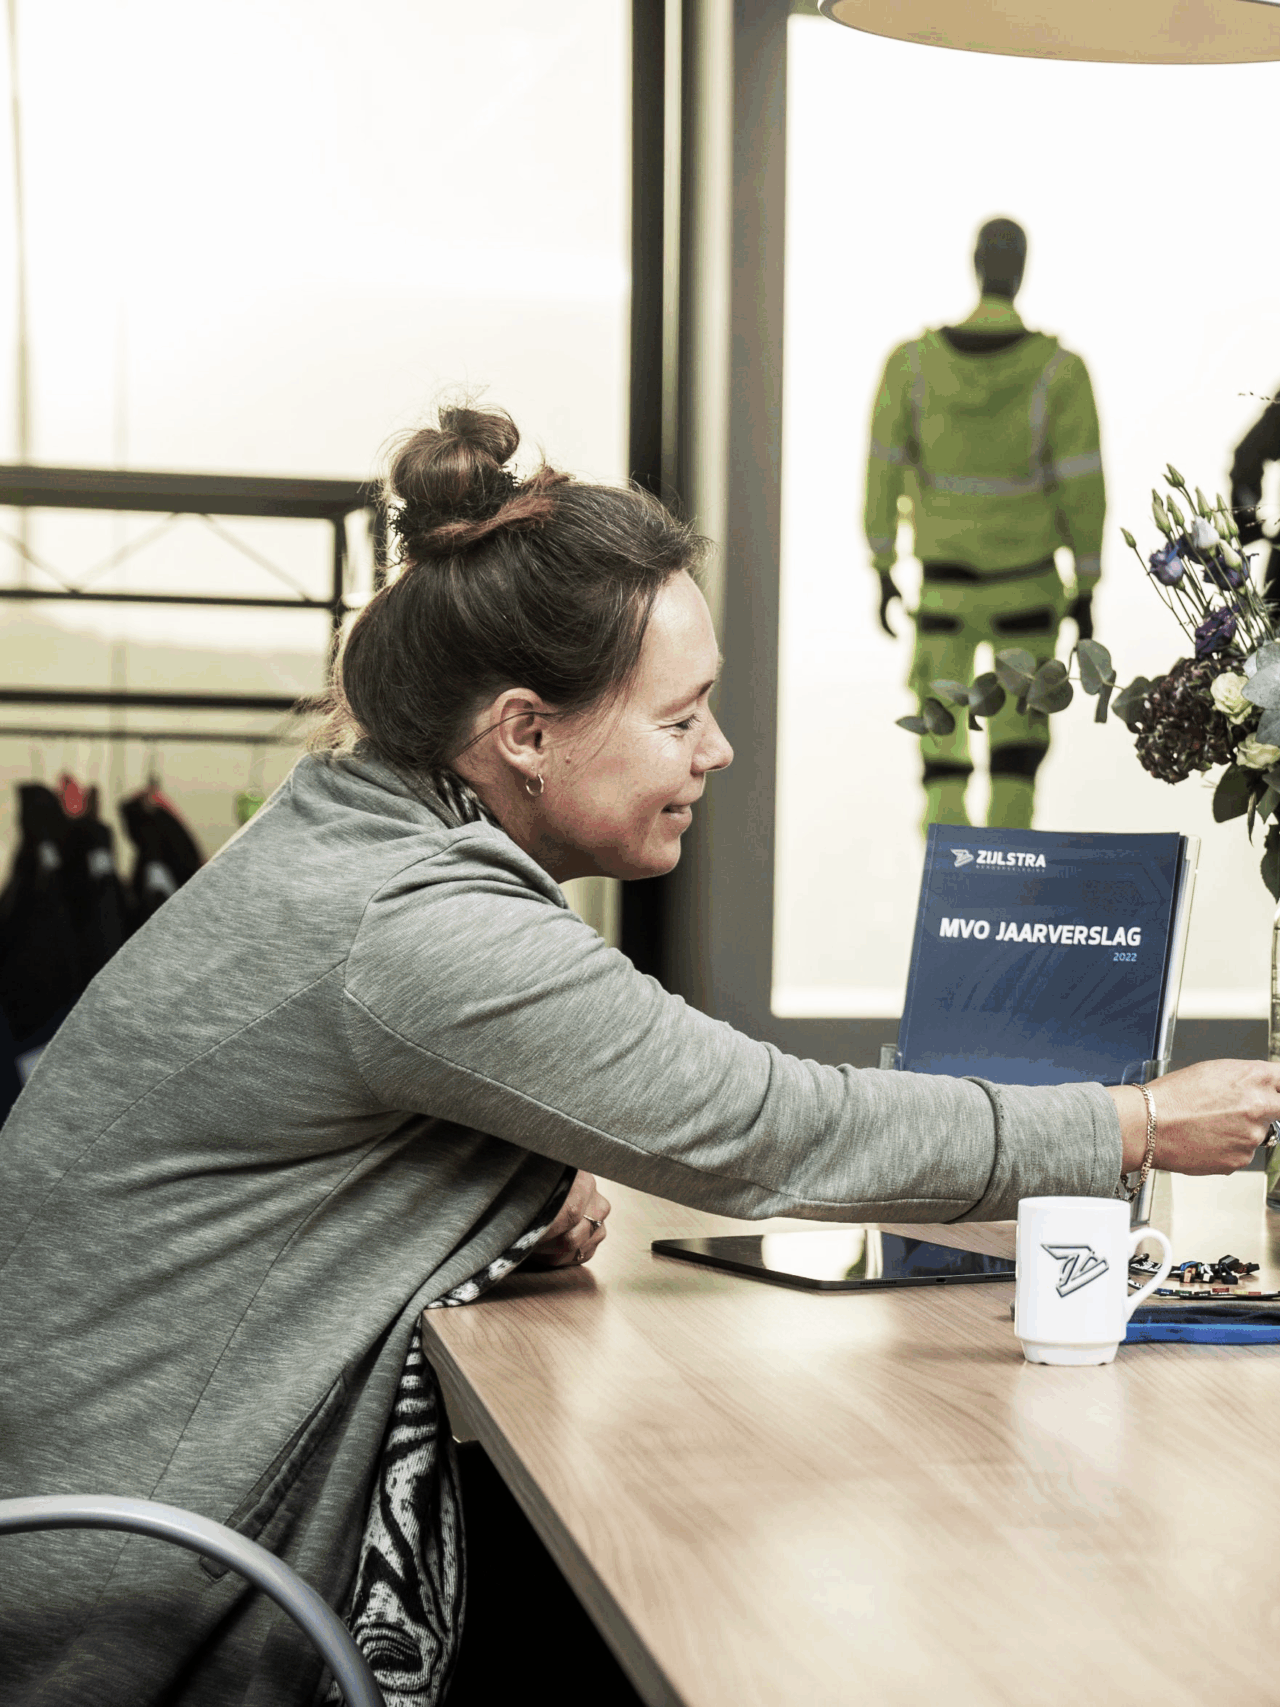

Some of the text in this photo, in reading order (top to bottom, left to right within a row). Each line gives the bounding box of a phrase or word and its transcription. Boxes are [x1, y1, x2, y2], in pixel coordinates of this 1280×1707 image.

[976, 849, 1046, 868] ZIJLSTRA
[939, 917, 1142, 947] MVO JAARVERSLAG
[1113, 952, 1137, 962] 2022
